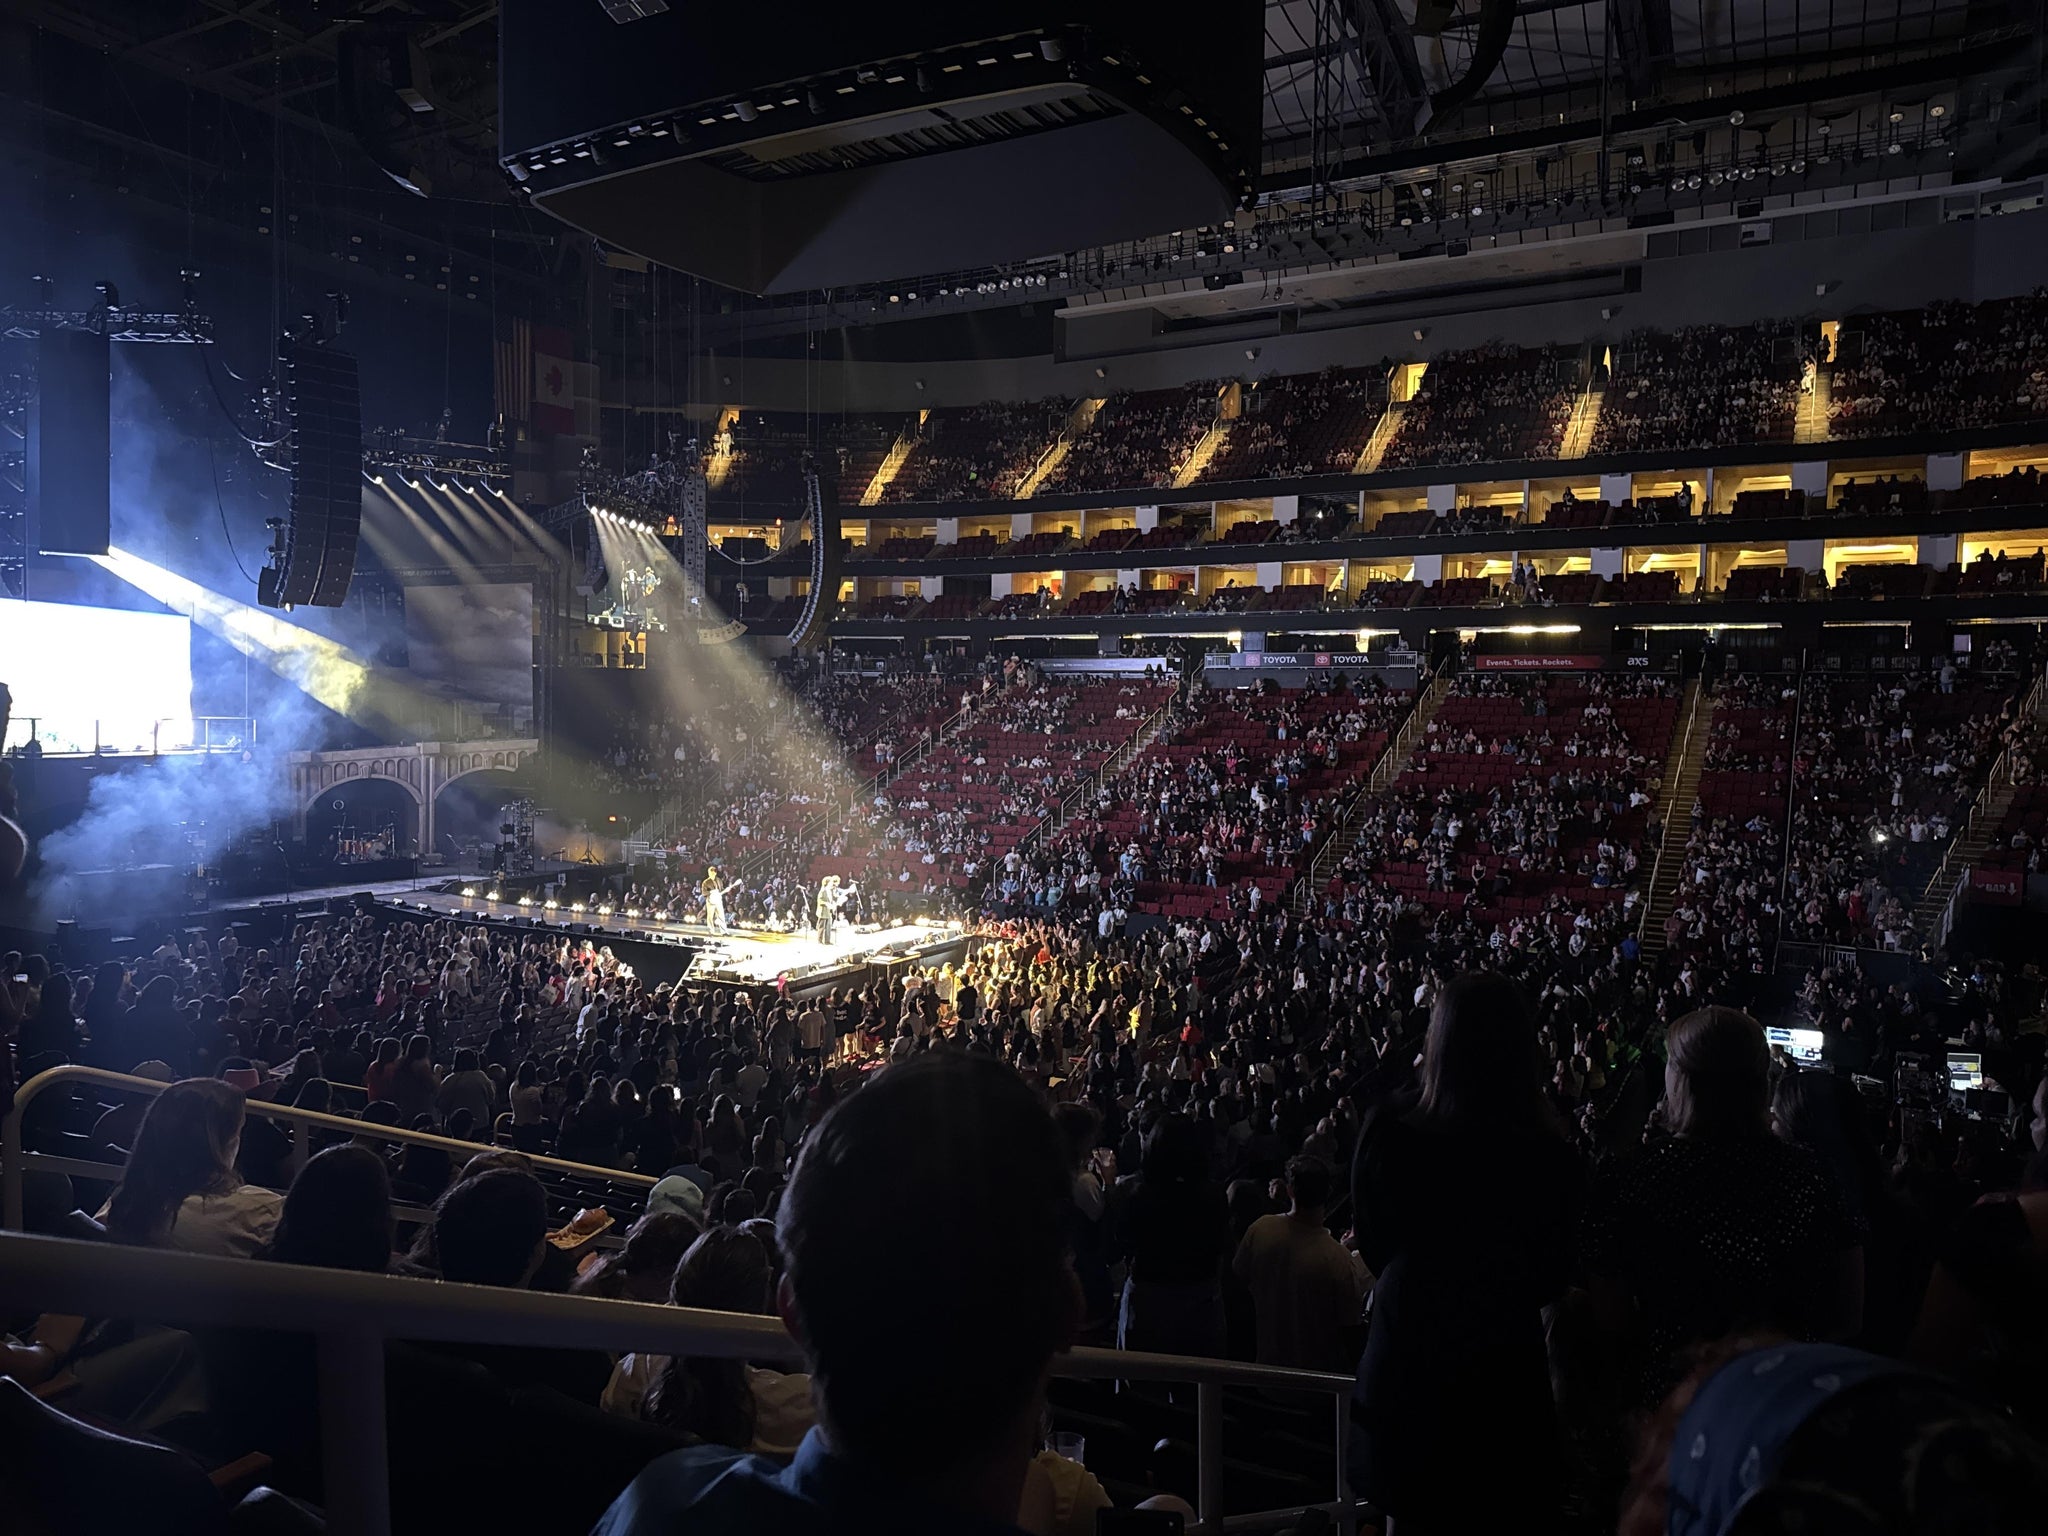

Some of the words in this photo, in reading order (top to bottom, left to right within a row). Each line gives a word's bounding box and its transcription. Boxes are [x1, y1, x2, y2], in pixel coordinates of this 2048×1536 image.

[1263, 656, 1297, 664] TOYOTA
[1333, 656, 1369, 664] TOYOTA
[1542, 658, 1574, 666] Rockets.
[1985, 883, 2006, 893] BAR
